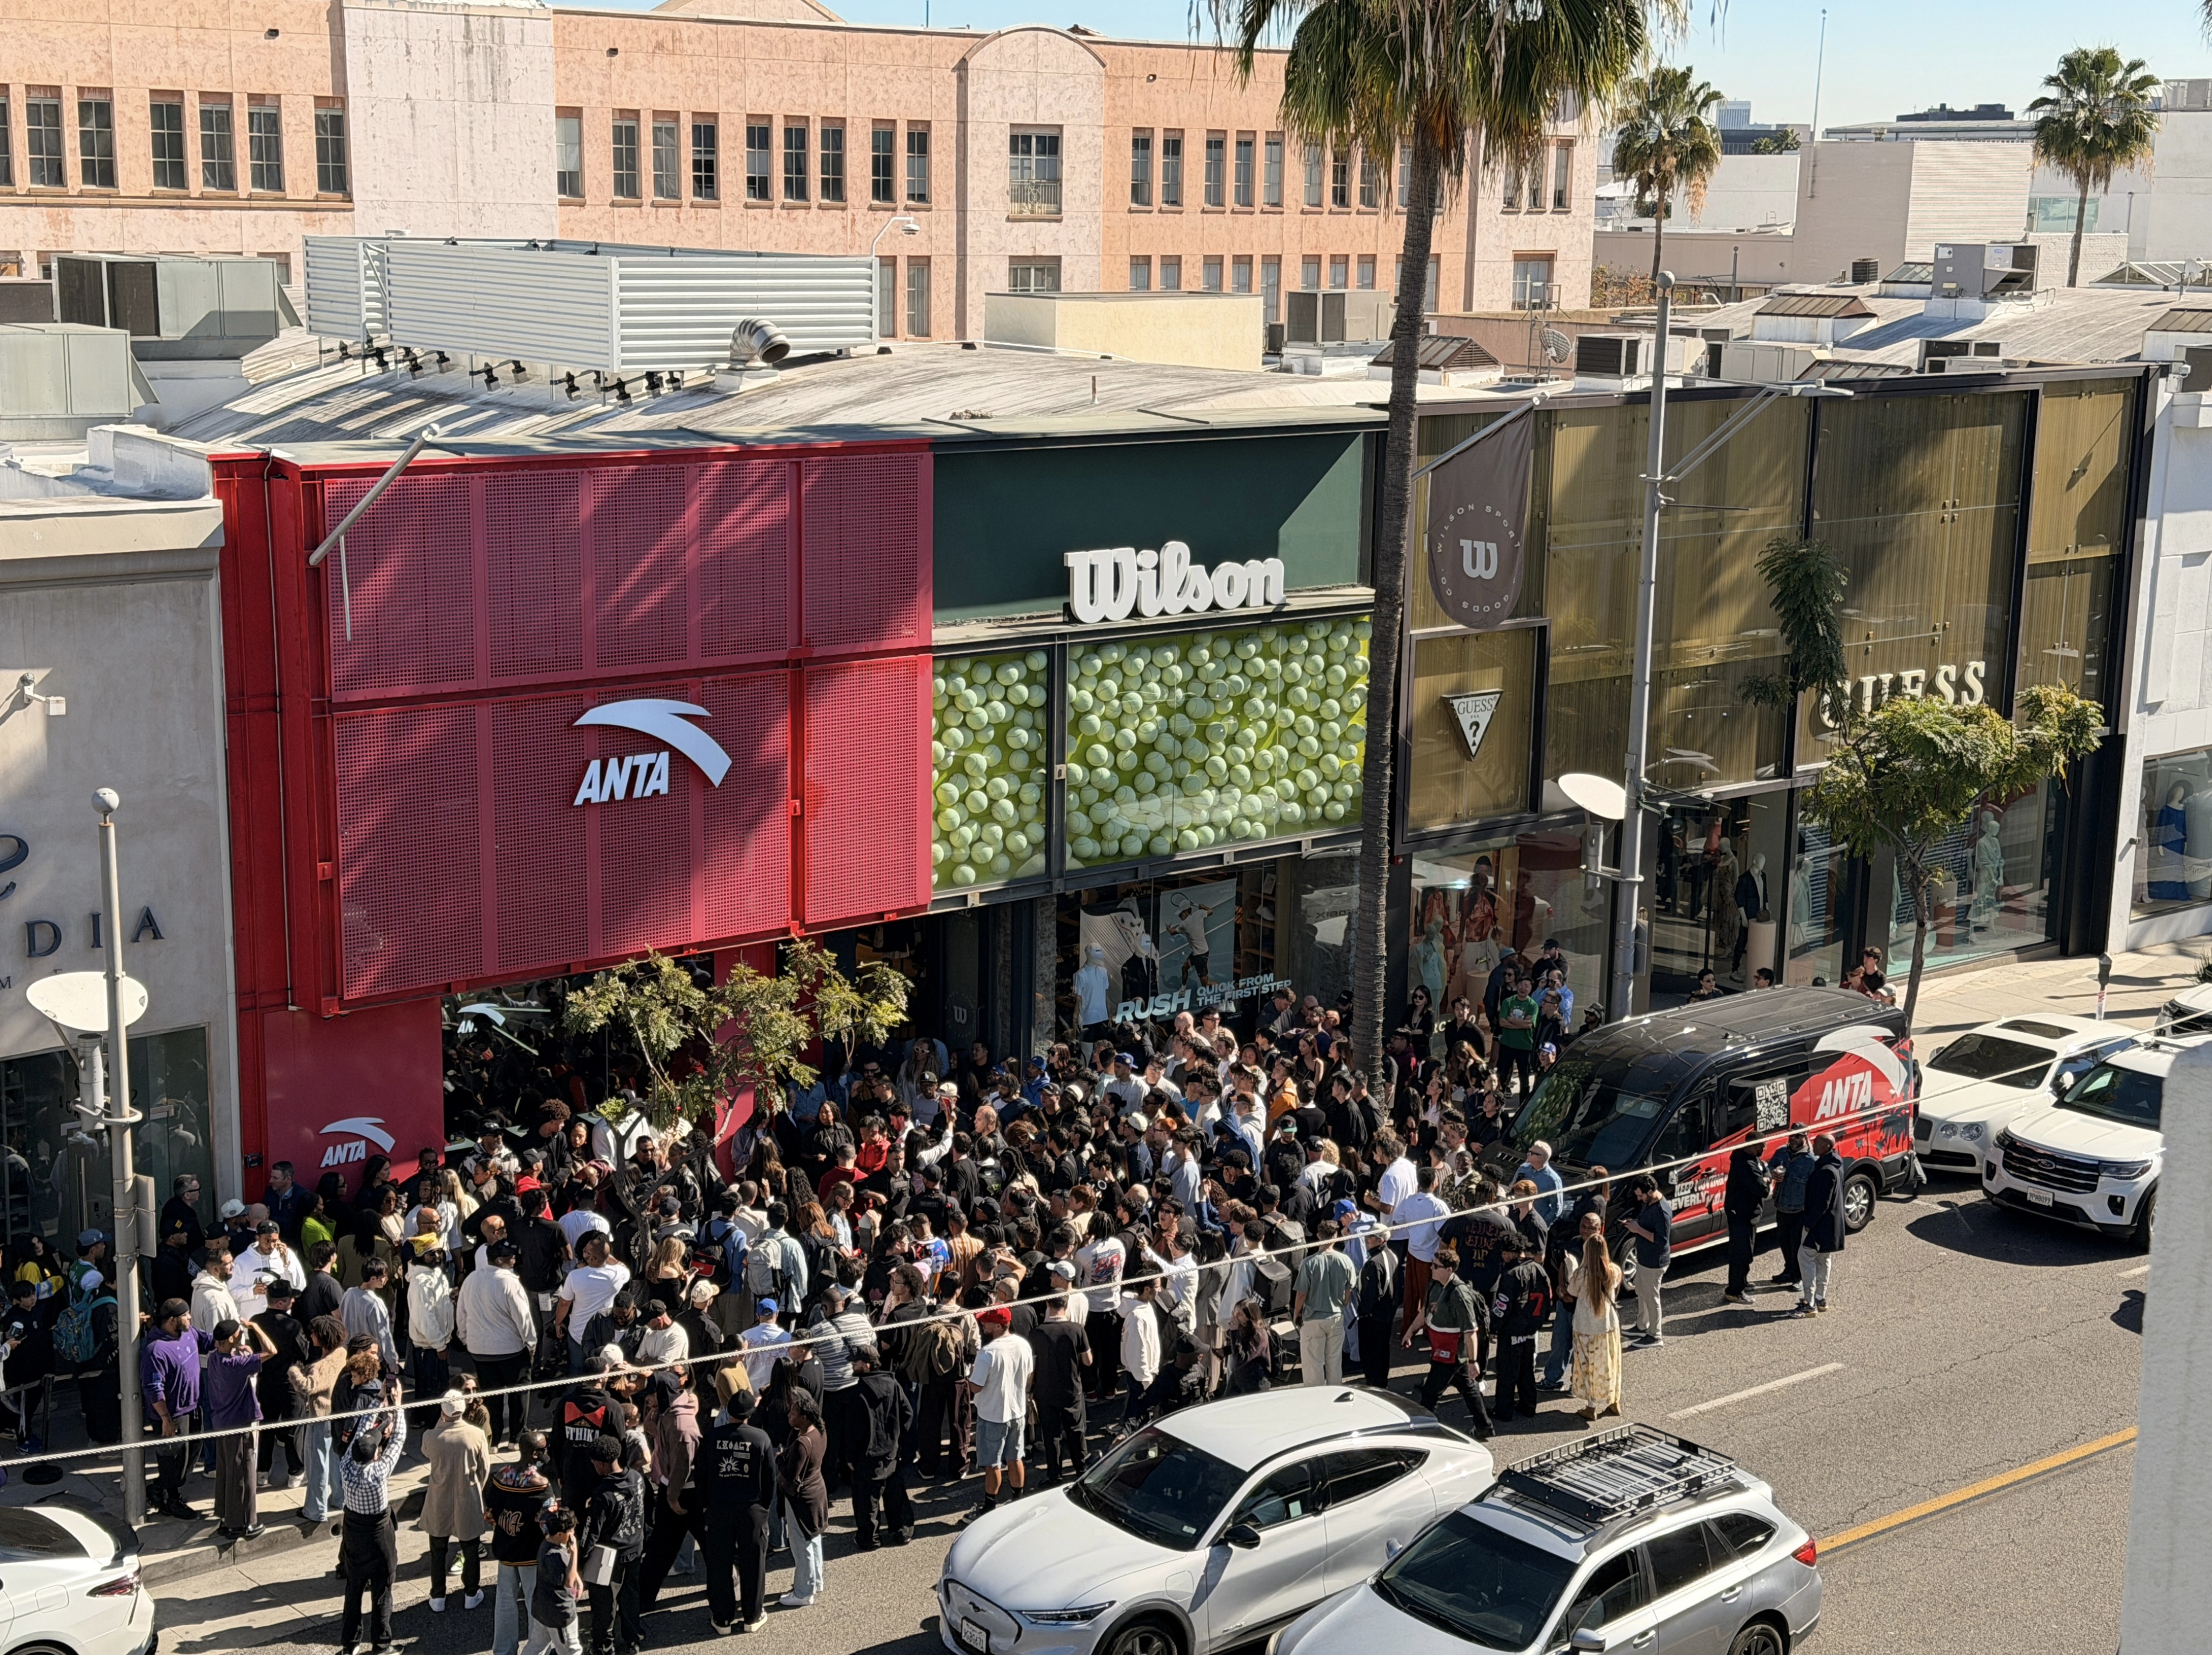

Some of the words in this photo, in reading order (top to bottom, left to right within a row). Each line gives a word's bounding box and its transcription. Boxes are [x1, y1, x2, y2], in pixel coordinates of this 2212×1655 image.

[1437, 503, 1474, 553] WILSON
[1462, 594, 1509, 612] GOODS
[1460, 539, 1498, 580] W
[1064, 541, 1286, 623] Wilson
[1457, 697, 1493, 715] GUESS
[573, 751, 670, 806] ANTA
[1197, 980, 1236, 996] QUICK
[1239, 973, 1274, 987] FROM
[1197, 993, 1221, 1007] THE
[1224, 986, 1258, 1001] FIRST
[1261, 979, 1291, 994] STEP
[1115, 989, 1191, 1024] RUSH
[457, 1020, 478, 1034] AN
[1814, 1070, 1872, 1121] ANTA
[320, 1139, 367, 1168] ANTA
[1675, 1180, 1694, 1197] KEEP
[1530, 1292, 1544, 1316] 7
